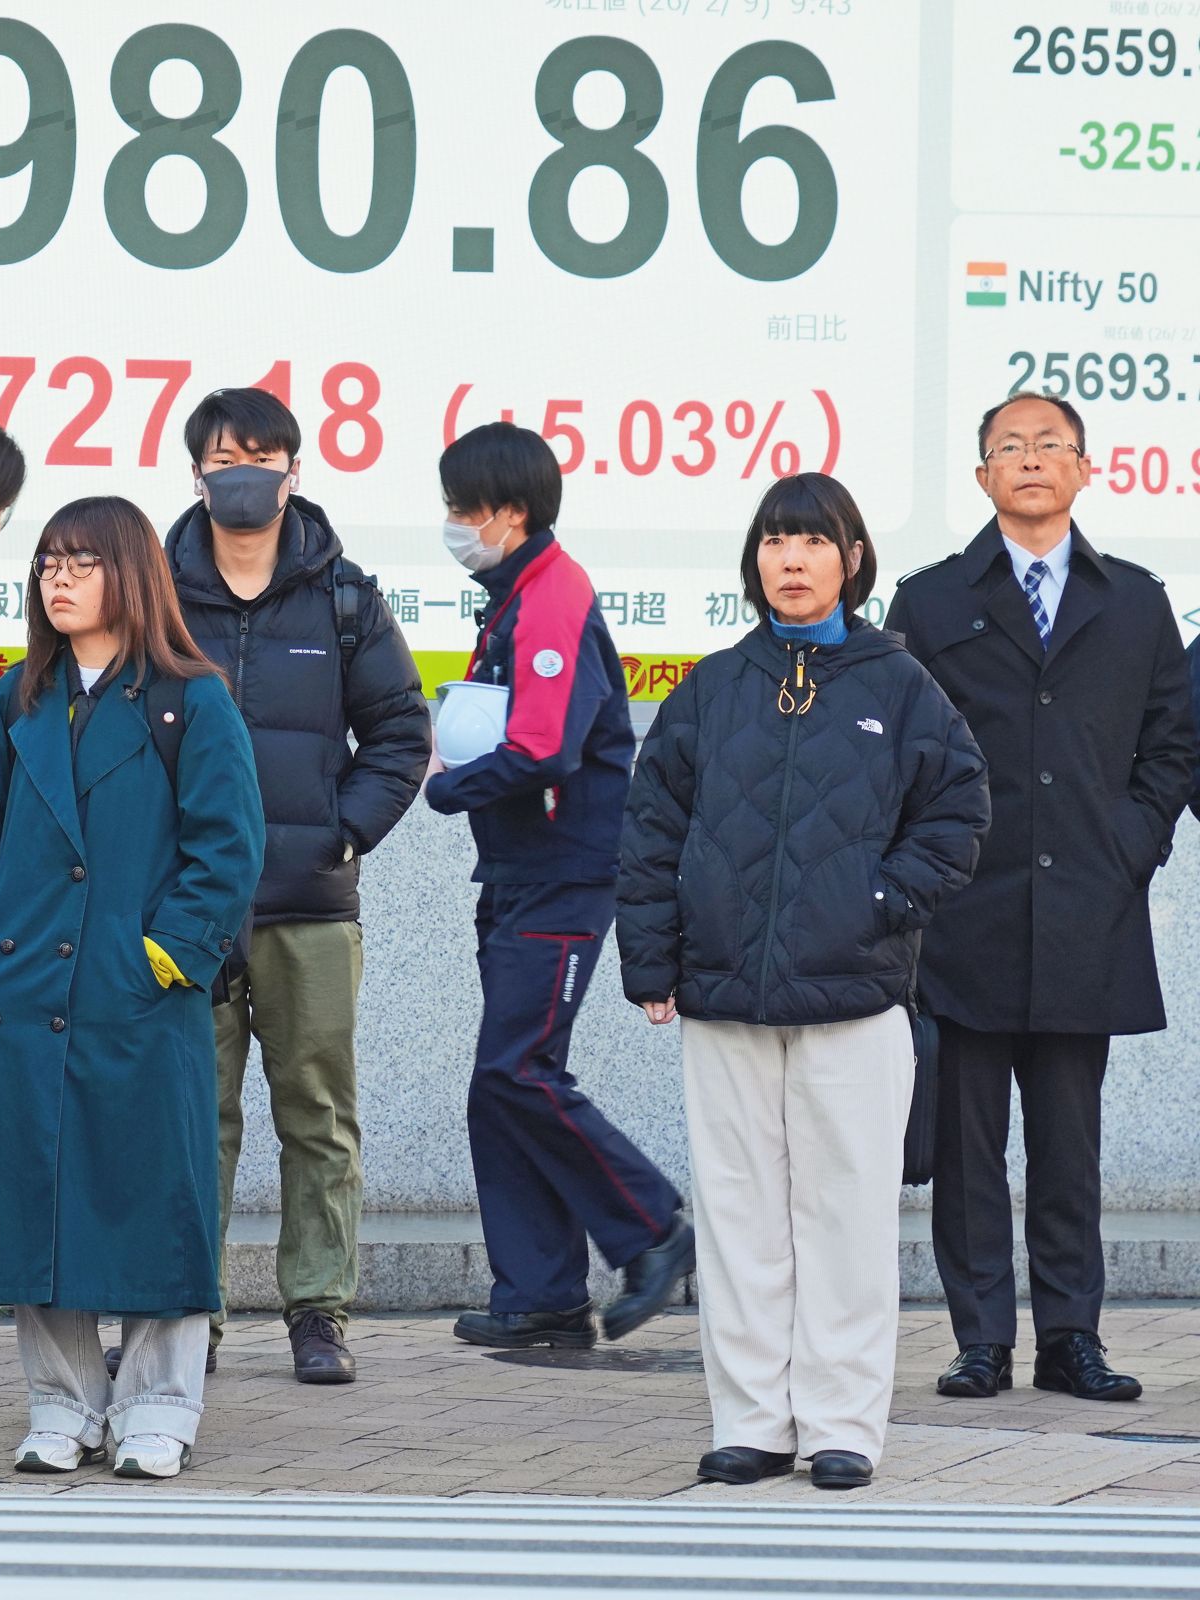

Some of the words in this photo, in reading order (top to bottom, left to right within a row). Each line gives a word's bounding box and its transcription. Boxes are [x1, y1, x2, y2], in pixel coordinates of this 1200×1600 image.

[1012, 25, 1200, 77] 26559.
[1059, 121, 1200, 172] -325.
[1019, 270, 1103, 311] Nifty
[1117, 272, 1158, 303] 50
[766, 314, 848, 342] 前日比
[1007, 351, 1200, 401] 25693.
[443, 384, 841, 479] (5.03%)
[1087, 446, 1200, 495] +50.
